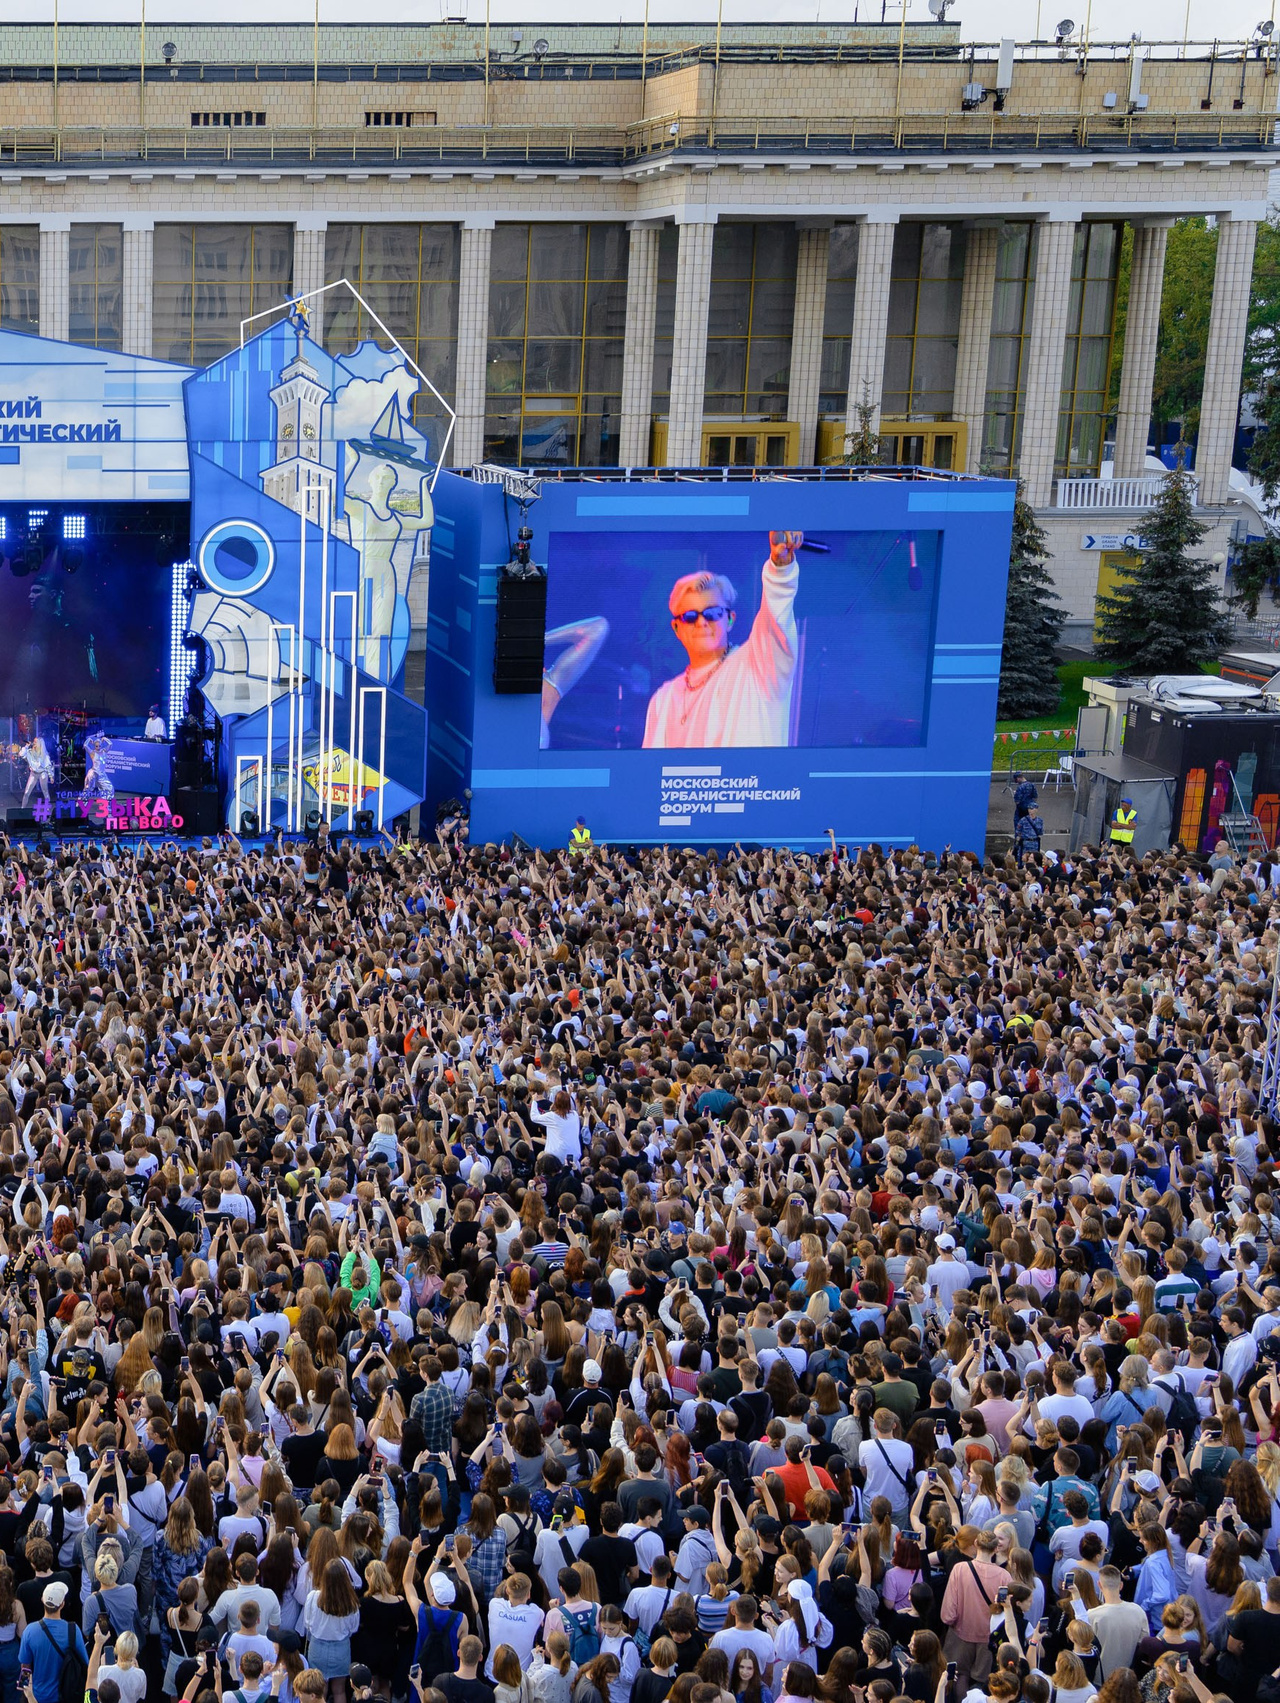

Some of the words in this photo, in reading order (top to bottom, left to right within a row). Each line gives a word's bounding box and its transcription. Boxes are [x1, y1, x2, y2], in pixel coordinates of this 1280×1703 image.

[661, 776, 758, 788] МОСКОВСКИЙ
[662, 788, 800, 801] УРБАНИСТИЧЕСКИЙ
[32, 796, 172, 822] #МУЗЫКА
[660, 803, 712, 813] ФОРУМ
[106, 814, 184, 831] ПЕВОГО
[498, 1610, 527, 1623] CASUAL
